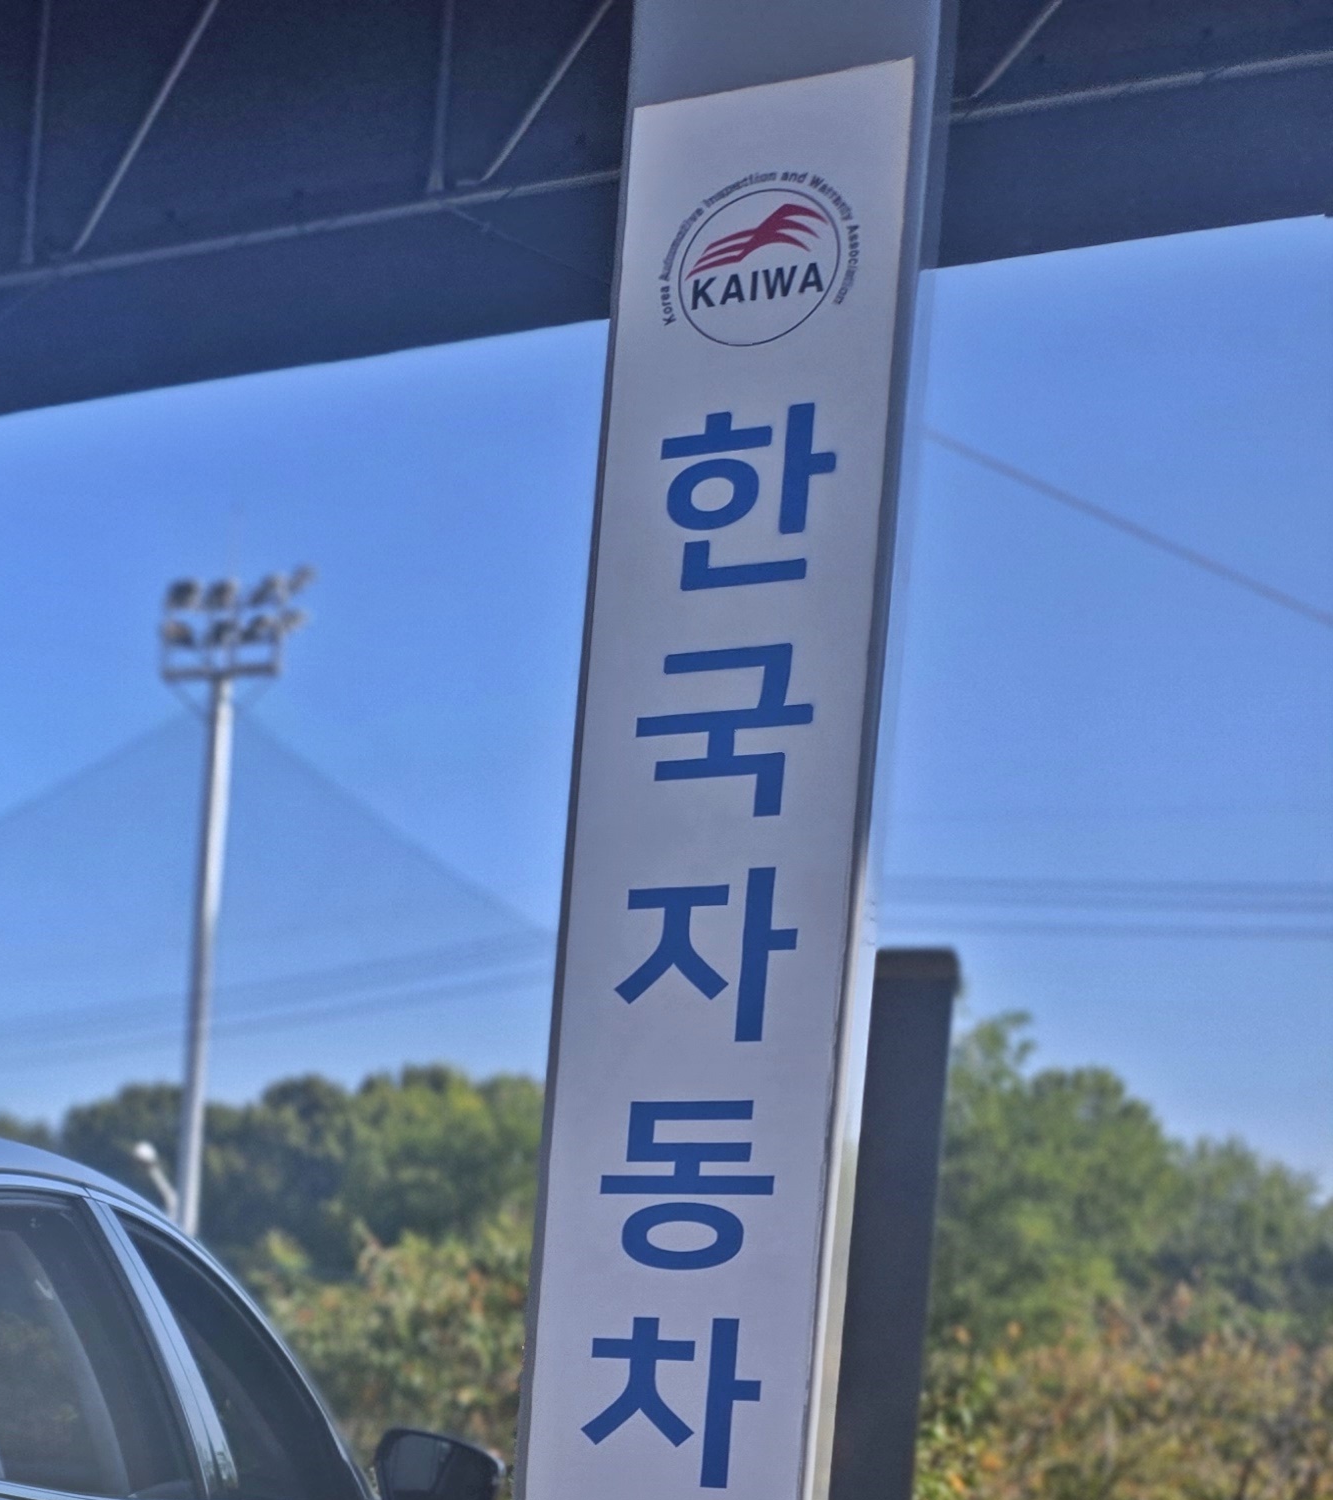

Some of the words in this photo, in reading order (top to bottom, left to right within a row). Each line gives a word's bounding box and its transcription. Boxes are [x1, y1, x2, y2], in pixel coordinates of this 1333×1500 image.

[660, 285, 677, 326] Korea
[780, 171, 808, 183] and
[690, 262, 824, 310] KAIWA
